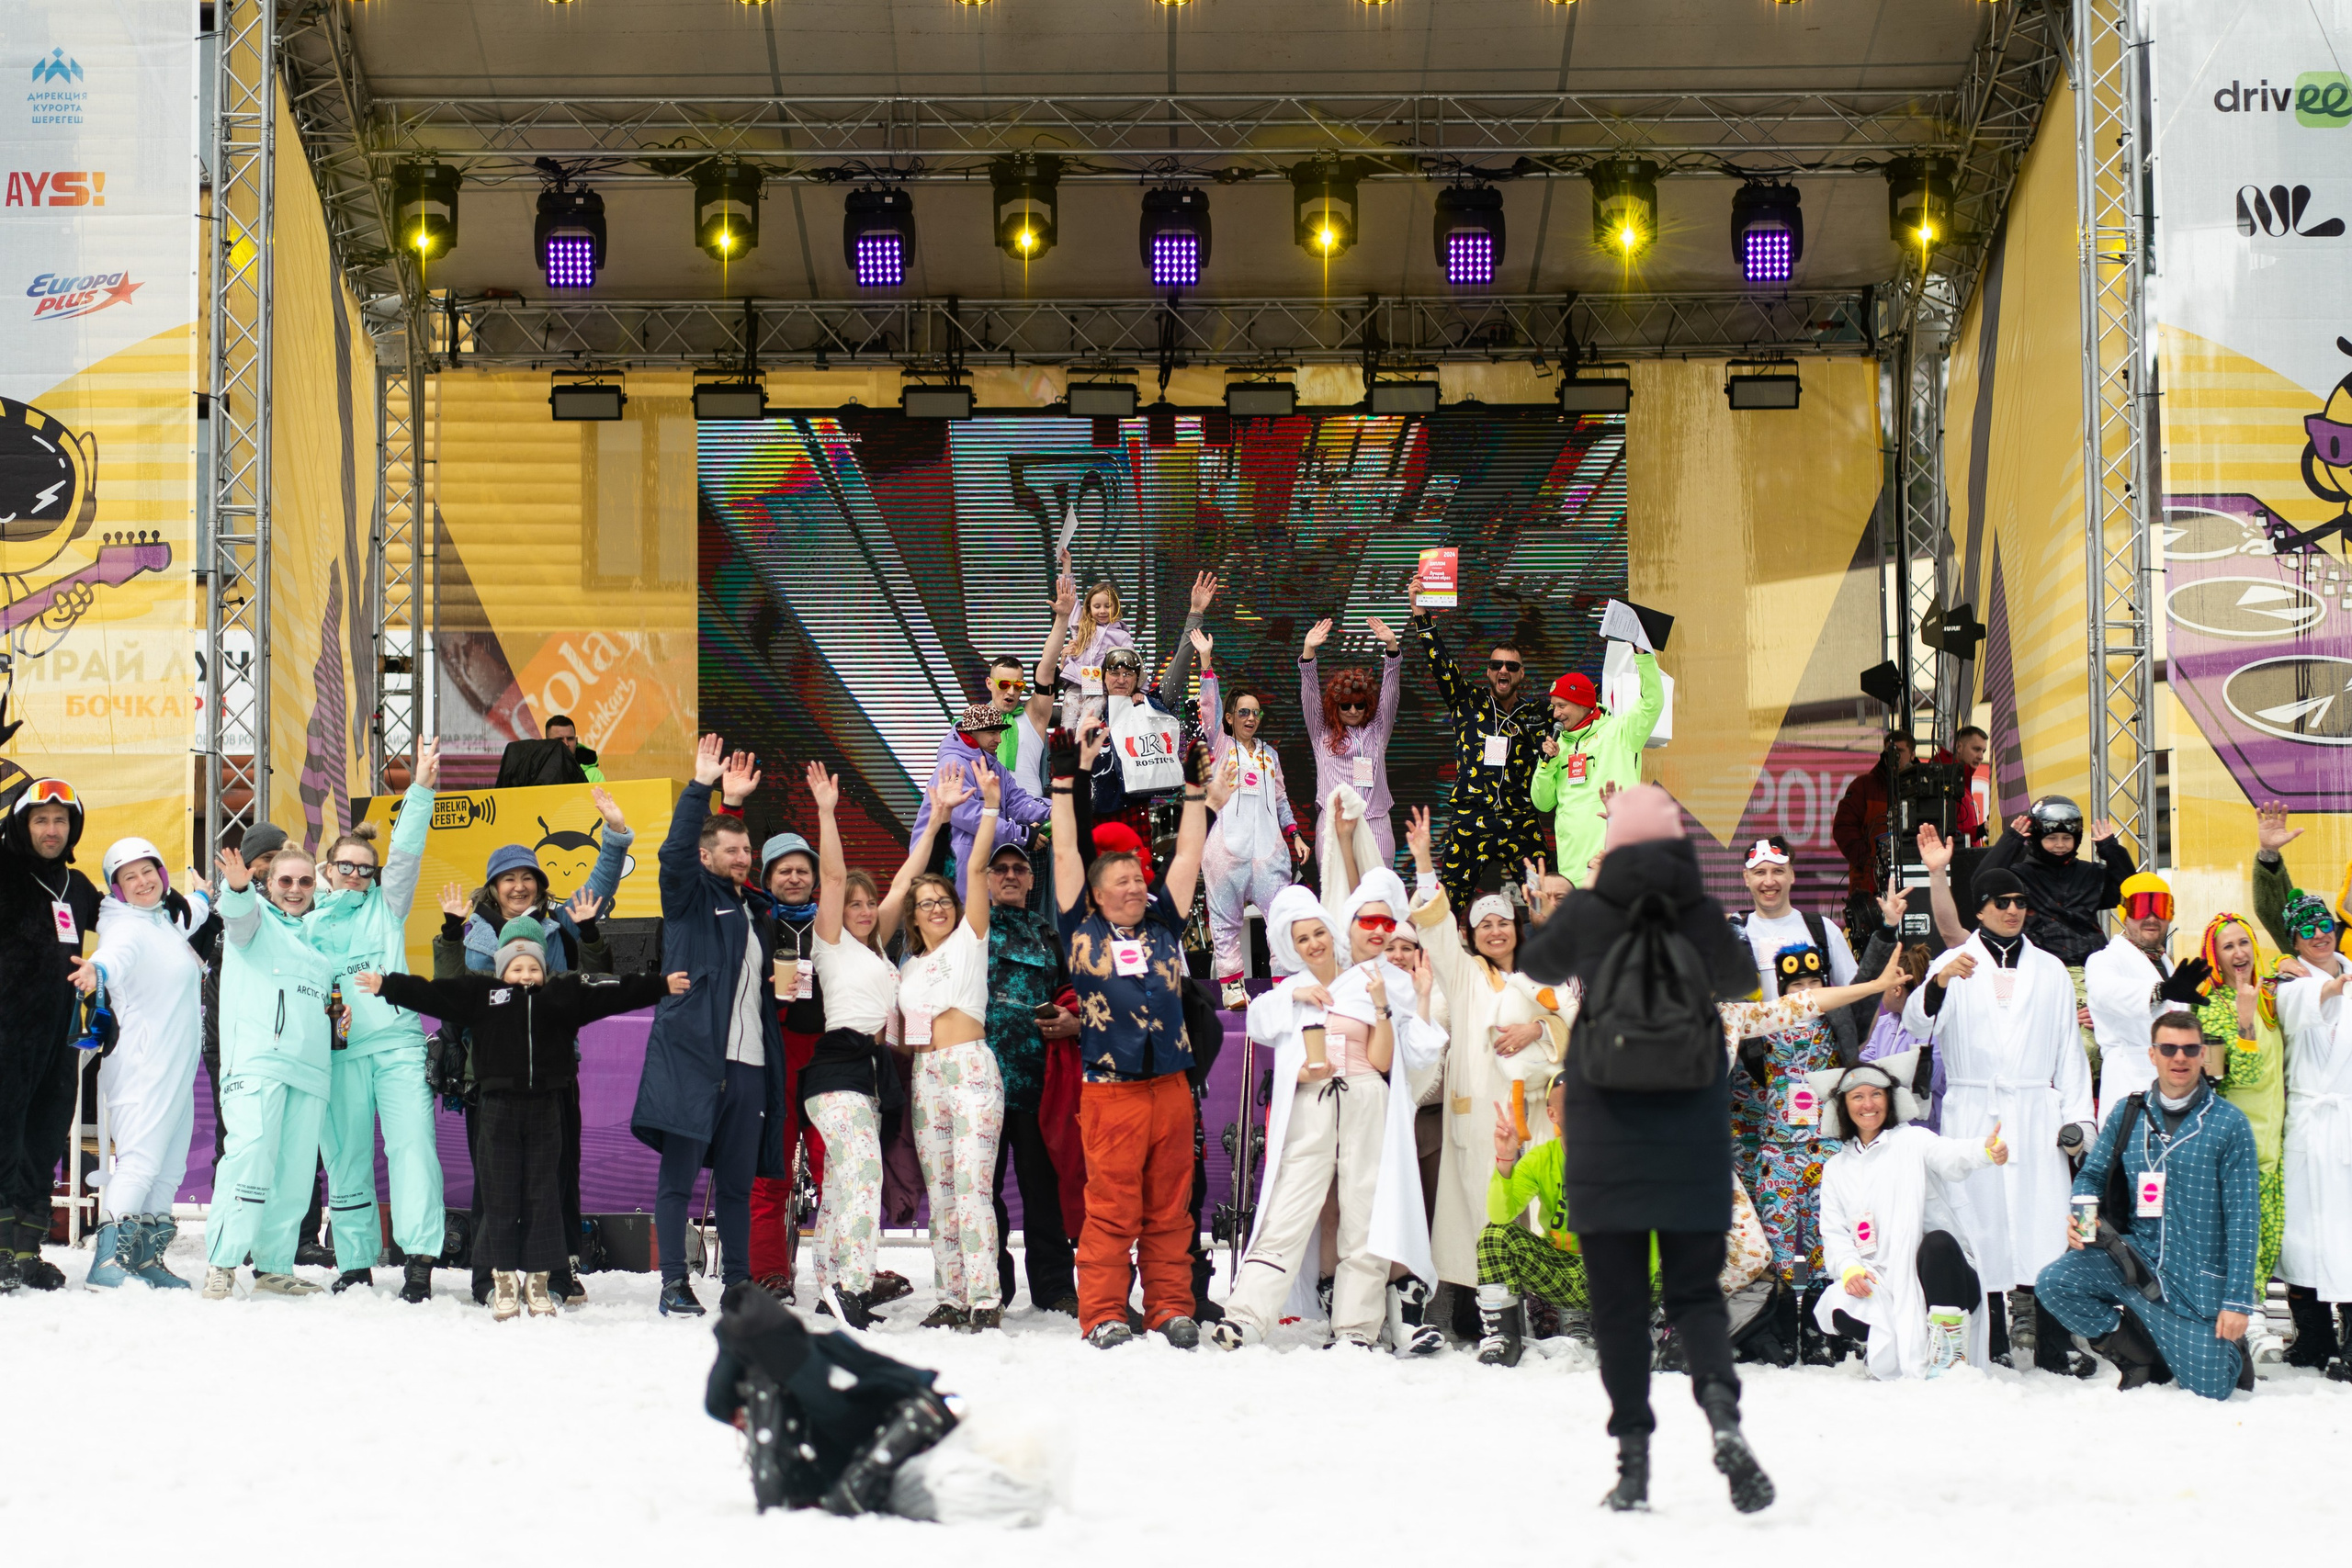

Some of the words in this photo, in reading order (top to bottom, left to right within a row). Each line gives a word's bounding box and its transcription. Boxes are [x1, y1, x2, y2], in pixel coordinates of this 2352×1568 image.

[27, 92, 87, 102] ДИРЕКЦИЯ
[33, 103, 83, 112] КУРОРТА
[32, 115, 84, 124] ШЕРЕГЕШ
[6, 172, 106, 207] AYS!
[16, 640, 144, 682] ИРАЙ
[435, 800, 467, 813] GRELKA
[435, 814, 457, 825] FEST
[347, 961, 370, 975] QUEEN
[297, 985, 320, 998] ARCTIC
